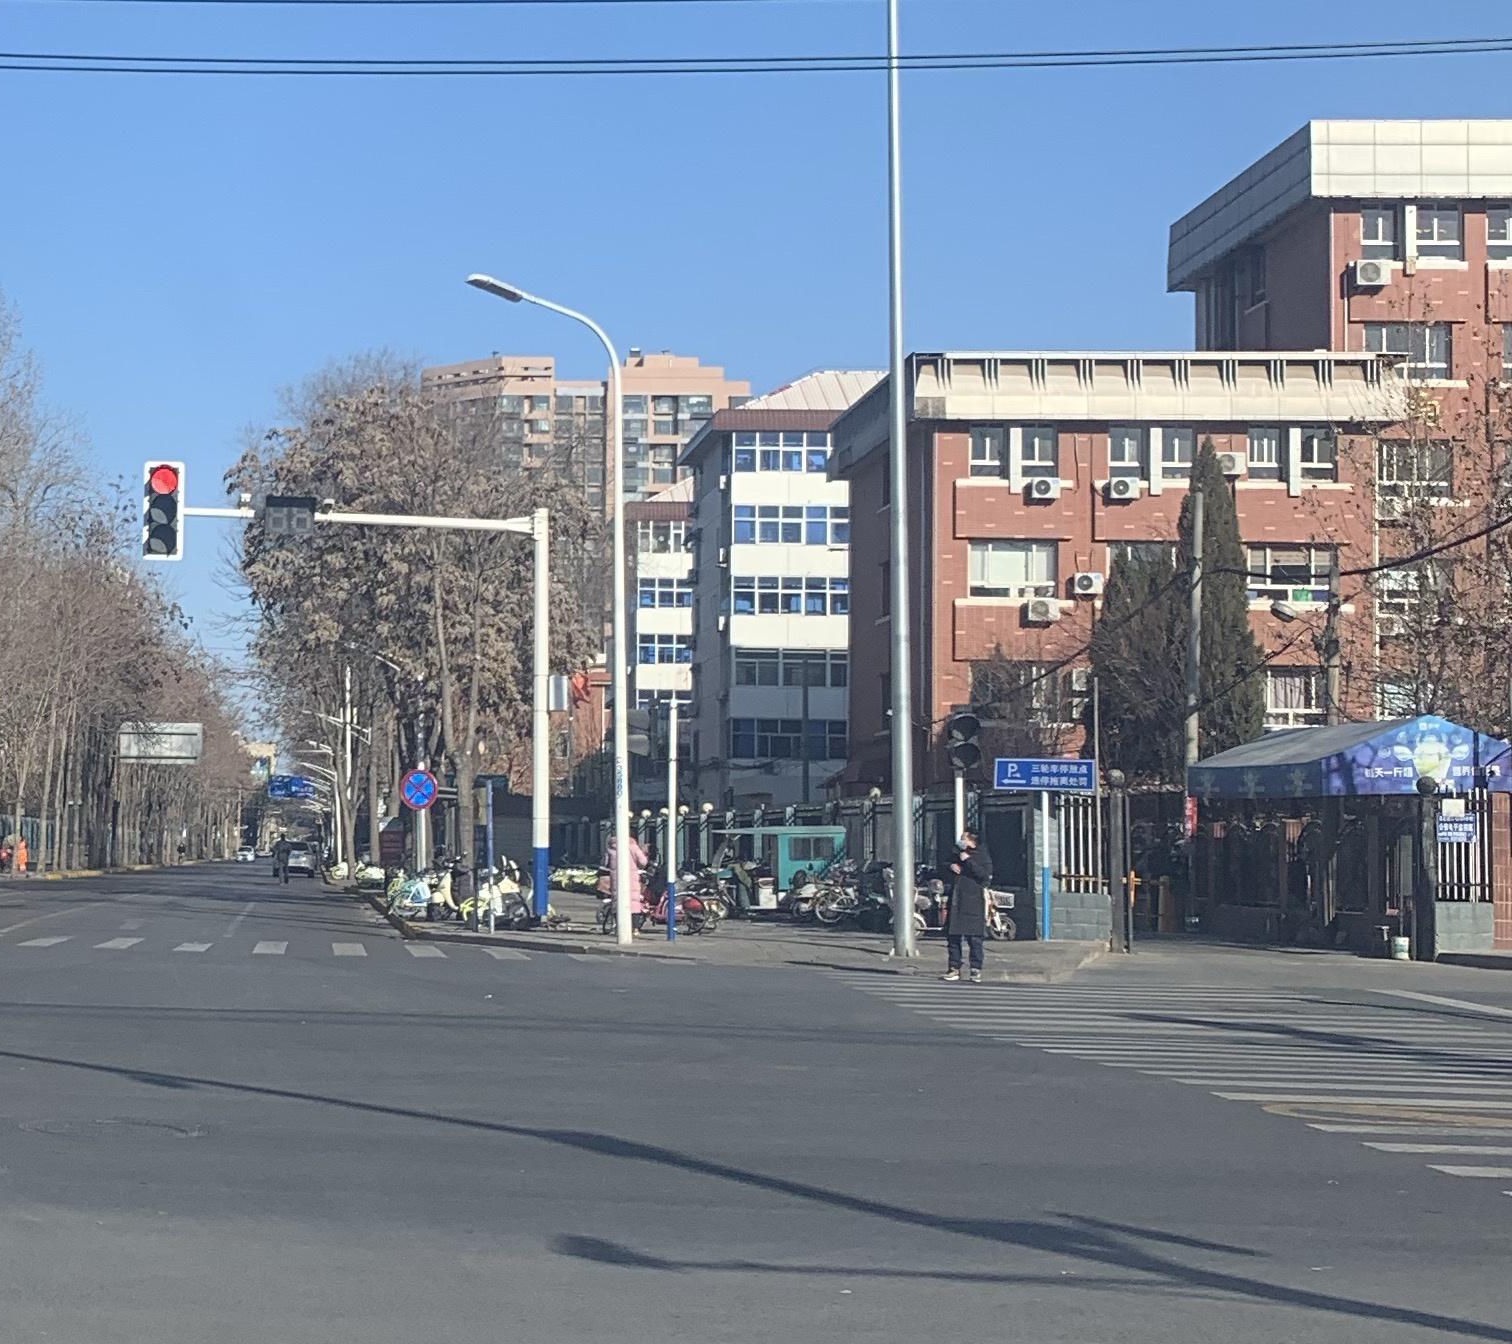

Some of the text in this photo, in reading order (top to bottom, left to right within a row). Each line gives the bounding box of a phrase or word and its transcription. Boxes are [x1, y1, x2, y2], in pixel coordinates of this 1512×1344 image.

[1031, 764, 1088, 774] 三轮车停放点
